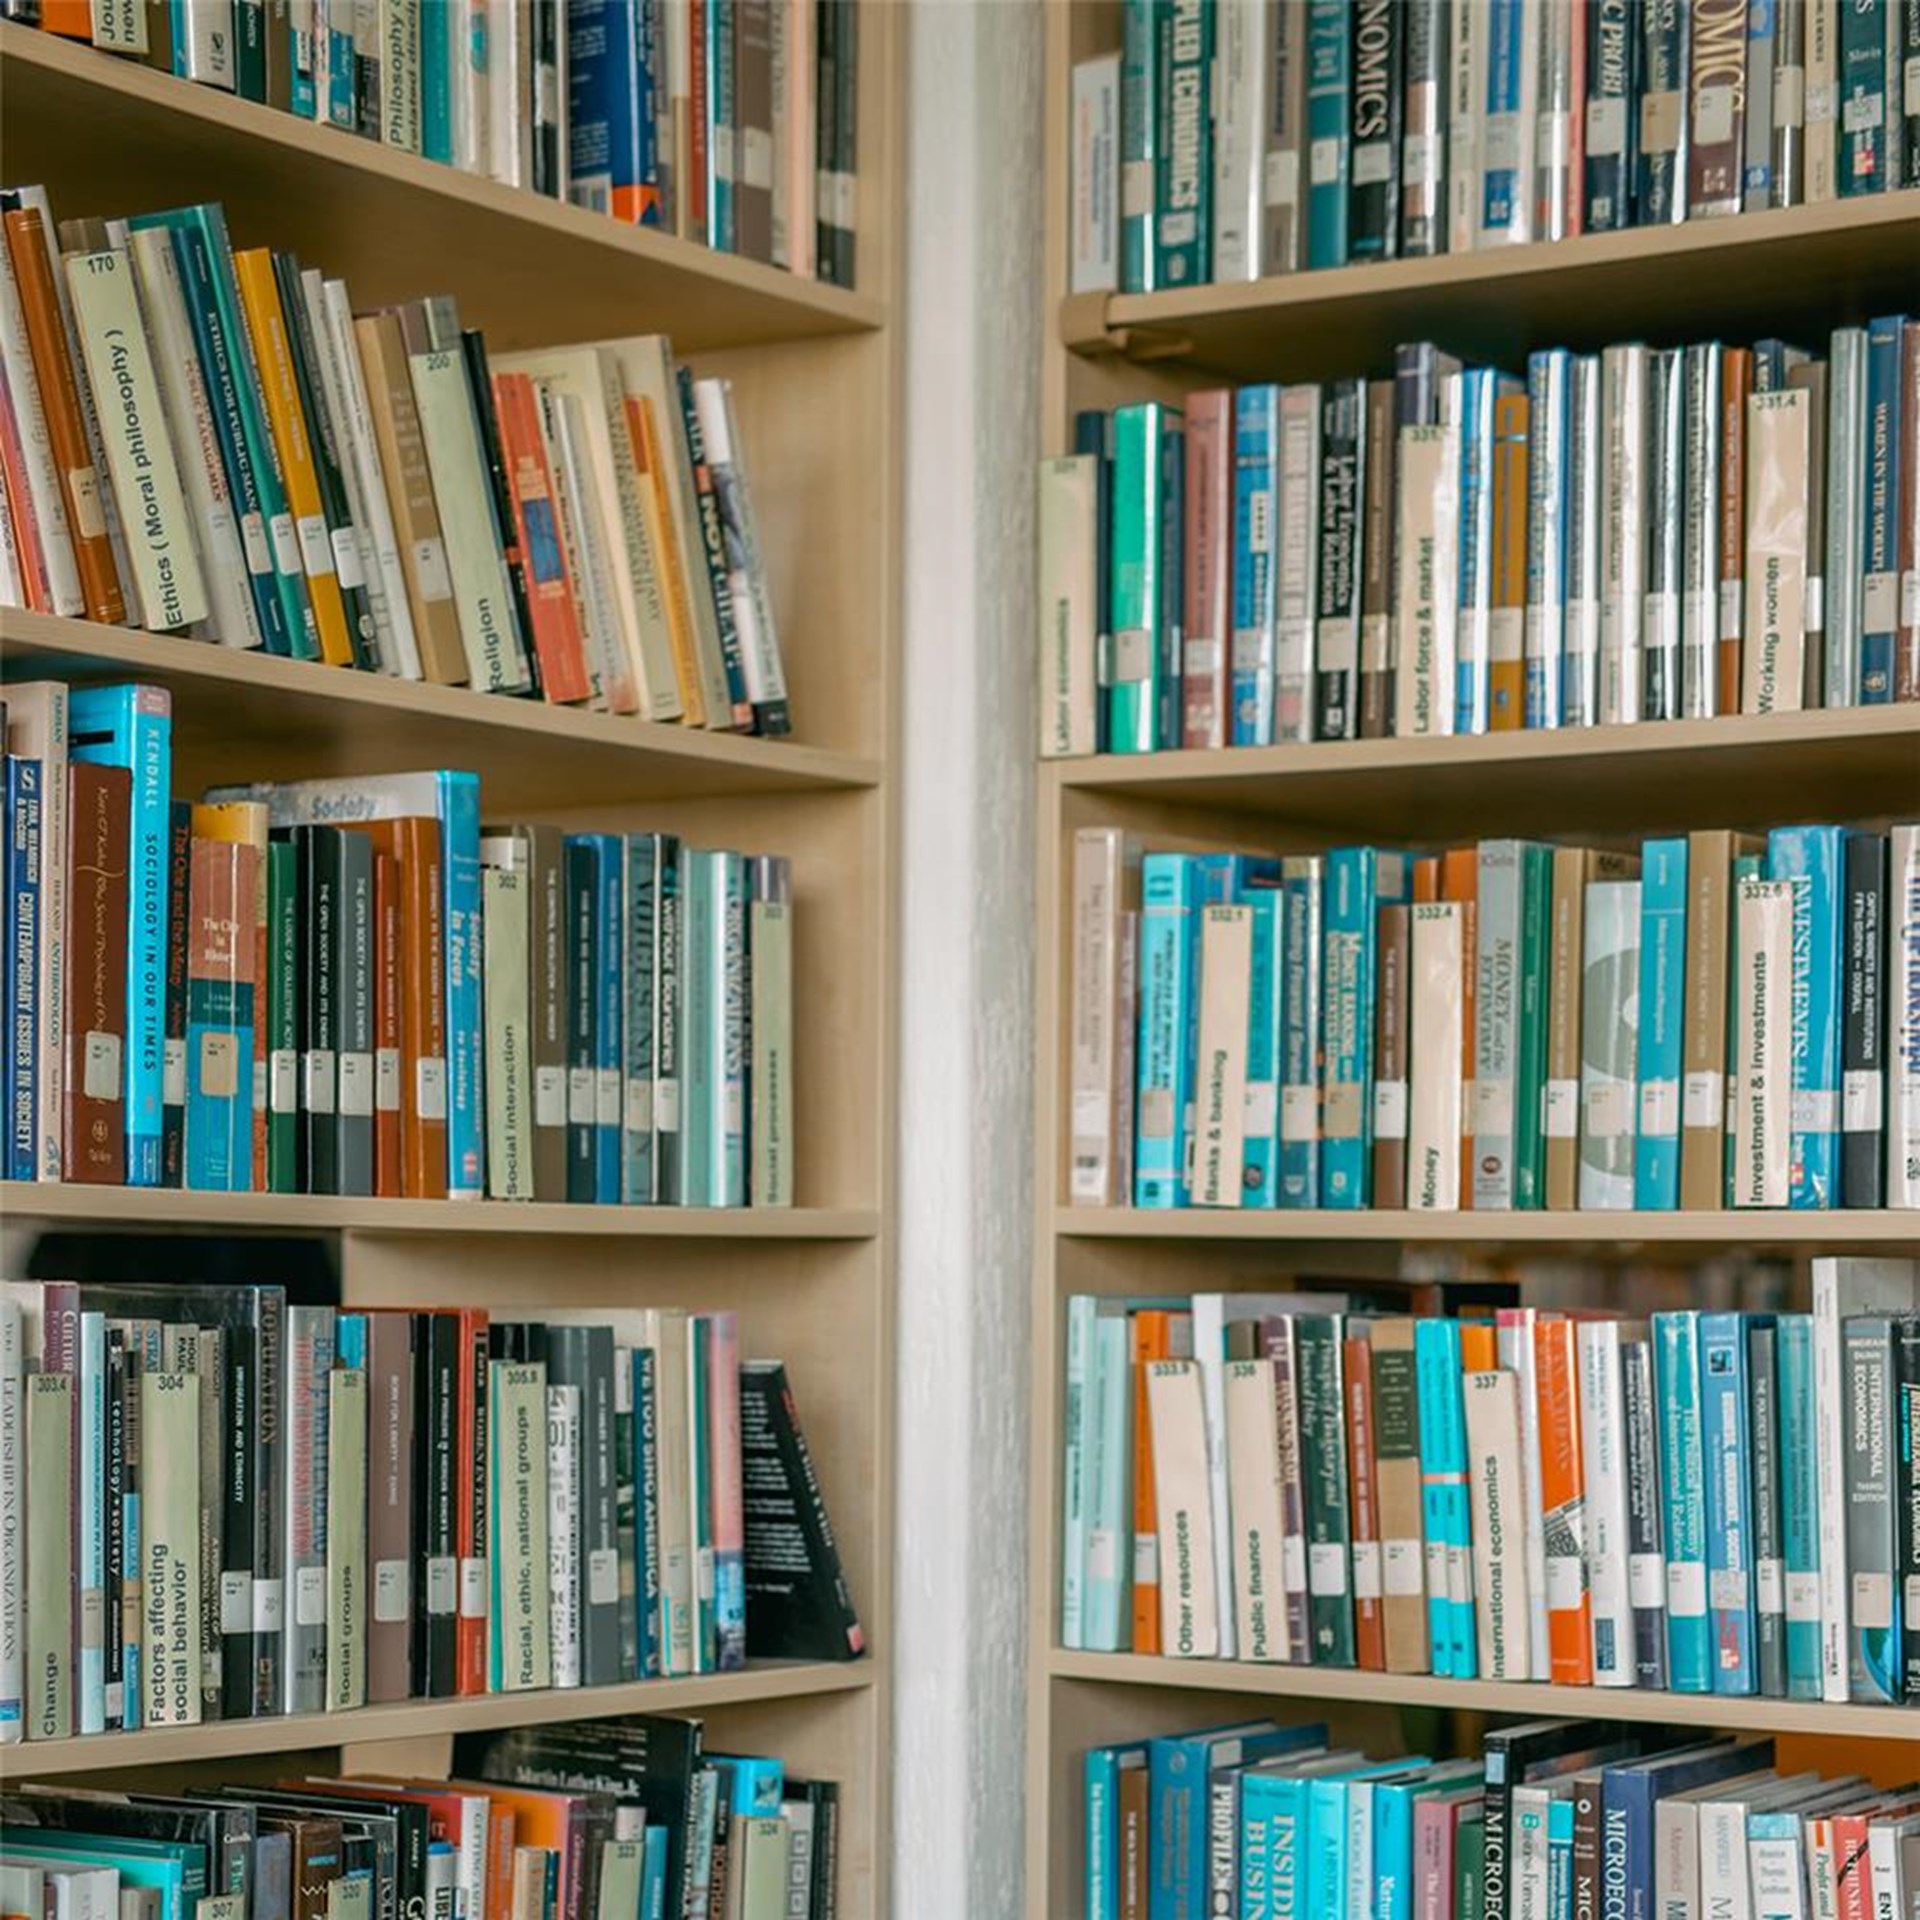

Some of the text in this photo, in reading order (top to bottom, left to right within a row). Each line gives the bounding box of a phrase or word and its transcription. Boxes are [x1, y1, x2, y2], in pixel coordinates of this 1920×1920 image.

[388, 11, 405, 145] Philosophy
[1171, 66, 1201, 210] ECONOMICS
[87, 254, 115, 276] 170
[208, 312, 232, 374] ETHICS
[217, 375, 237, 409] FOR
[1874, 402, 1888, 458] WOMEN
[224, 410, 248, 461] PUBLIC
[108, 344, 184, 627] Ethics Moral philosophy
[701, 496, 725, 569] NOT
[1321, 478, 1338, 615] Labor Relations
[1335, 456, 1355, 607] Labor Economics
[1417, 537, 1434, 602] market
[476, 598, 501, 692] Religion
[1414, 625, 1432, 675] force
[1758, 557, 1780, 715] Working women
[1413, 680, 1431, 734] Labor
[174, 827, 189, 853] The
[143, 728, 158, 1073] KENDALL SOCIOLOGY IN OUR TIMES
[284, 918, 293, 947] LOGIC
[320, 904, 328, 931] OPEN
[1865, 891, 1876, 930] CAPITAL
[320, 933, 328, 973] SOCIETY
[452, 934, 466, 988] Focus
[1494, 937, 1512, 1021] MONEY
[1790, 874, 1812, 1059] INVESTMENTS
[1864, 931, 1875, 974] MARKETS
[1864, 975, 1874, 996] AND
[16, 891, 34, 1152] CONTEMPORARY ISSUES IN SOCIETY
[283, 965, 293, 1021] COLLECTIVE
[1750, 951, 1769, 1070] investments
[504, 1024, 519, 1195] Social interaction
[1207, 1050, 1228, 1122] banking
[1203, 1147, 1220, 1203] Banks
[1420, 1146, 1441, 1209] Money
[1748, 1094, 1767, 1203] Investment
[60, 1309, 78, 1373] CULTUR
[260, 1299, 278, 1444] POPULATION
[157, 1374, 185, 1391] 304
[1475, 1374, 1498, 1390] 337
[1854, 1364, 1868, 1452] ECONOMICS
[1869, 1364, 1883, 1477] INTERNATIONAL
[514, 1406, 534, 1473] groups
[640, 1356, 659, 1599] WE TOO SING AMERICA
[0, 1376, 18, 1661] LEADERSHIP IN ORGANIZATIONS
[108, 1399, 122, 1576] technology society
[517, 1479, 534, 1556] national
[1174, 1509, 1193, 1656] Other resources
[1246, 1529, 1267, 1658] Public finance
[1483, 1455, 1505, 1679] International economics
[148, 1543, 170, 1723] Factors affecting
[171, 1559, 188, 1723] social behavior
[339, 1640, 353, 1703] Social
[43, 1652, 62, 1736] Change
[1271, 1814, 1296, 1920] INSID
